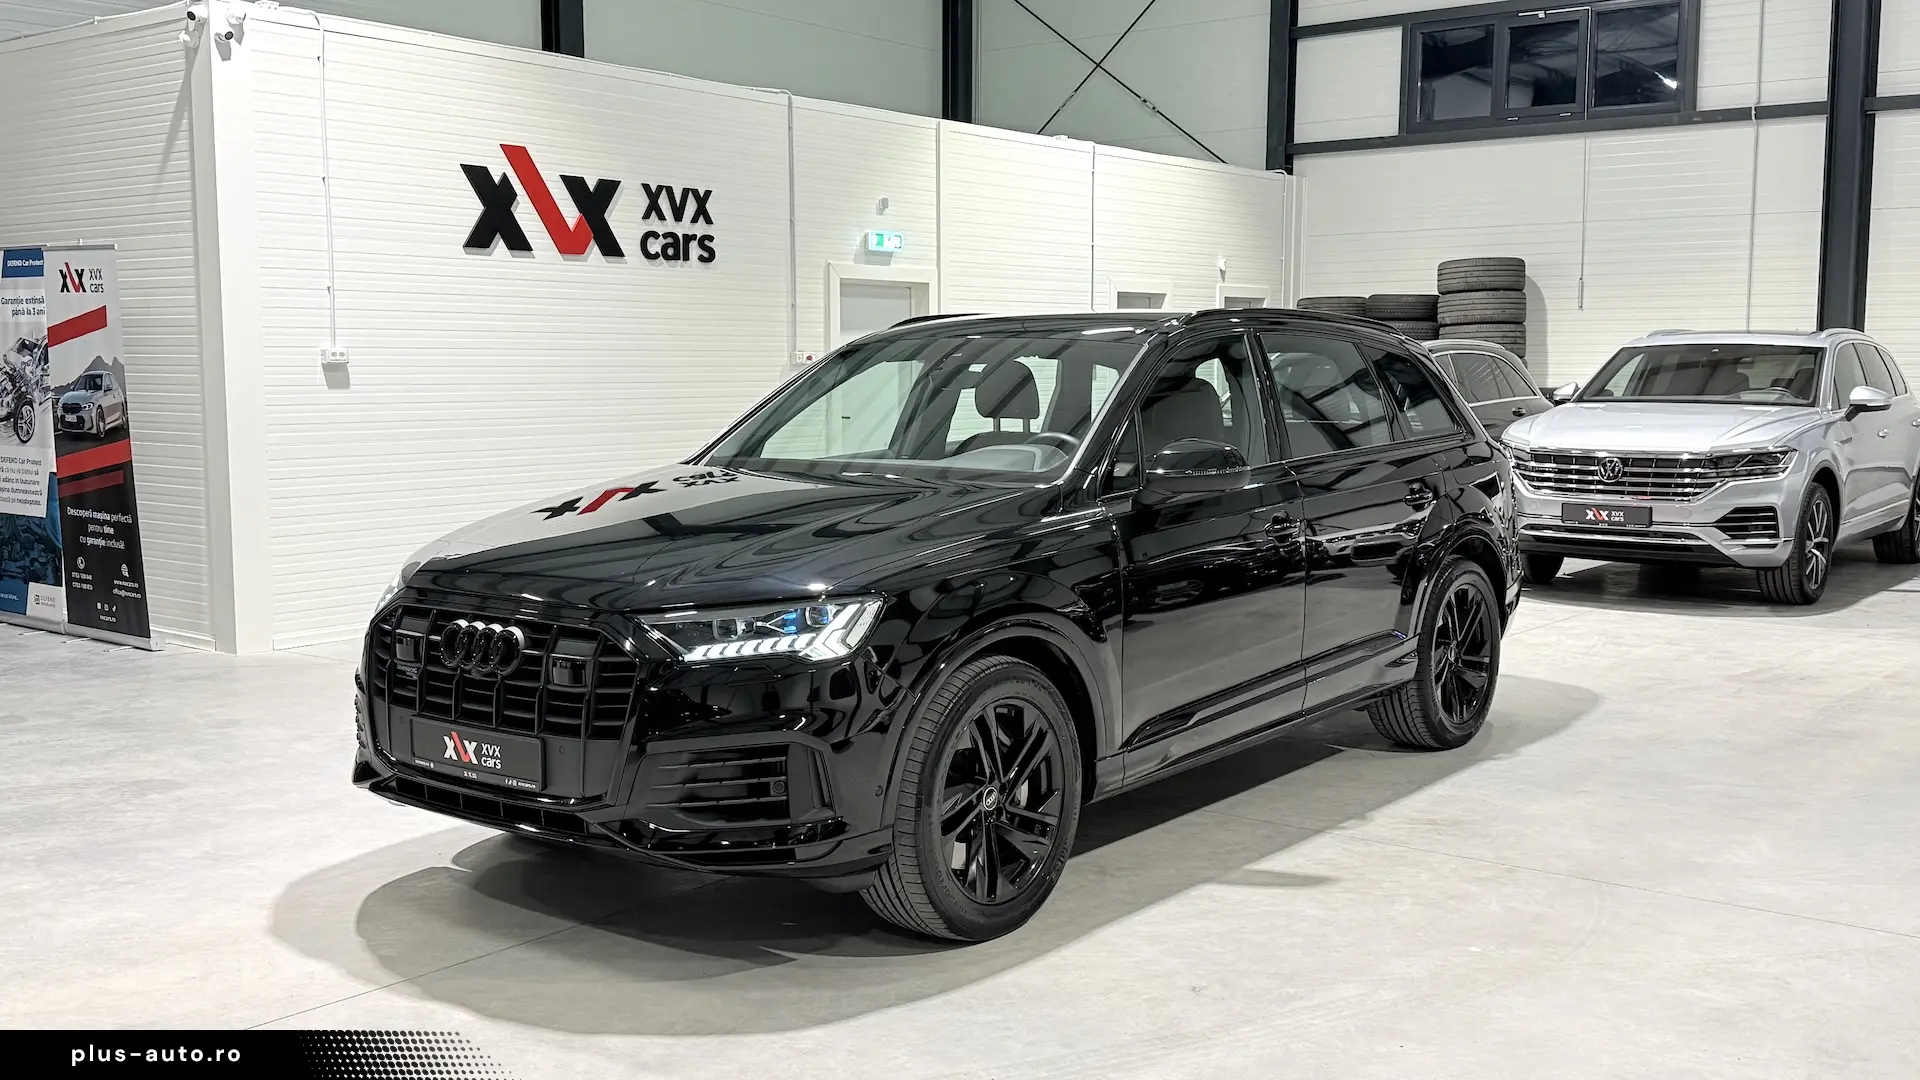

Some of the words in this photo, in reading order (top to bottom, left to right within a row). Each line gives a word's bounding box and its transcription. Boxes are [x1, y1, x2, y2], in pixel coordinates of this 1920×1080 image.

[640, 182, 713, 225] XVX
[639, 230, 716, 263] cars
[88, 268, 103, 281] XVX
[89, 283, 104, 293] cars
[103, 524, 115, 535] tine
[79, 535, 87, 544] cu
[481, 742, 501, 758] XVX
[481, 756, 502, 769] cars
